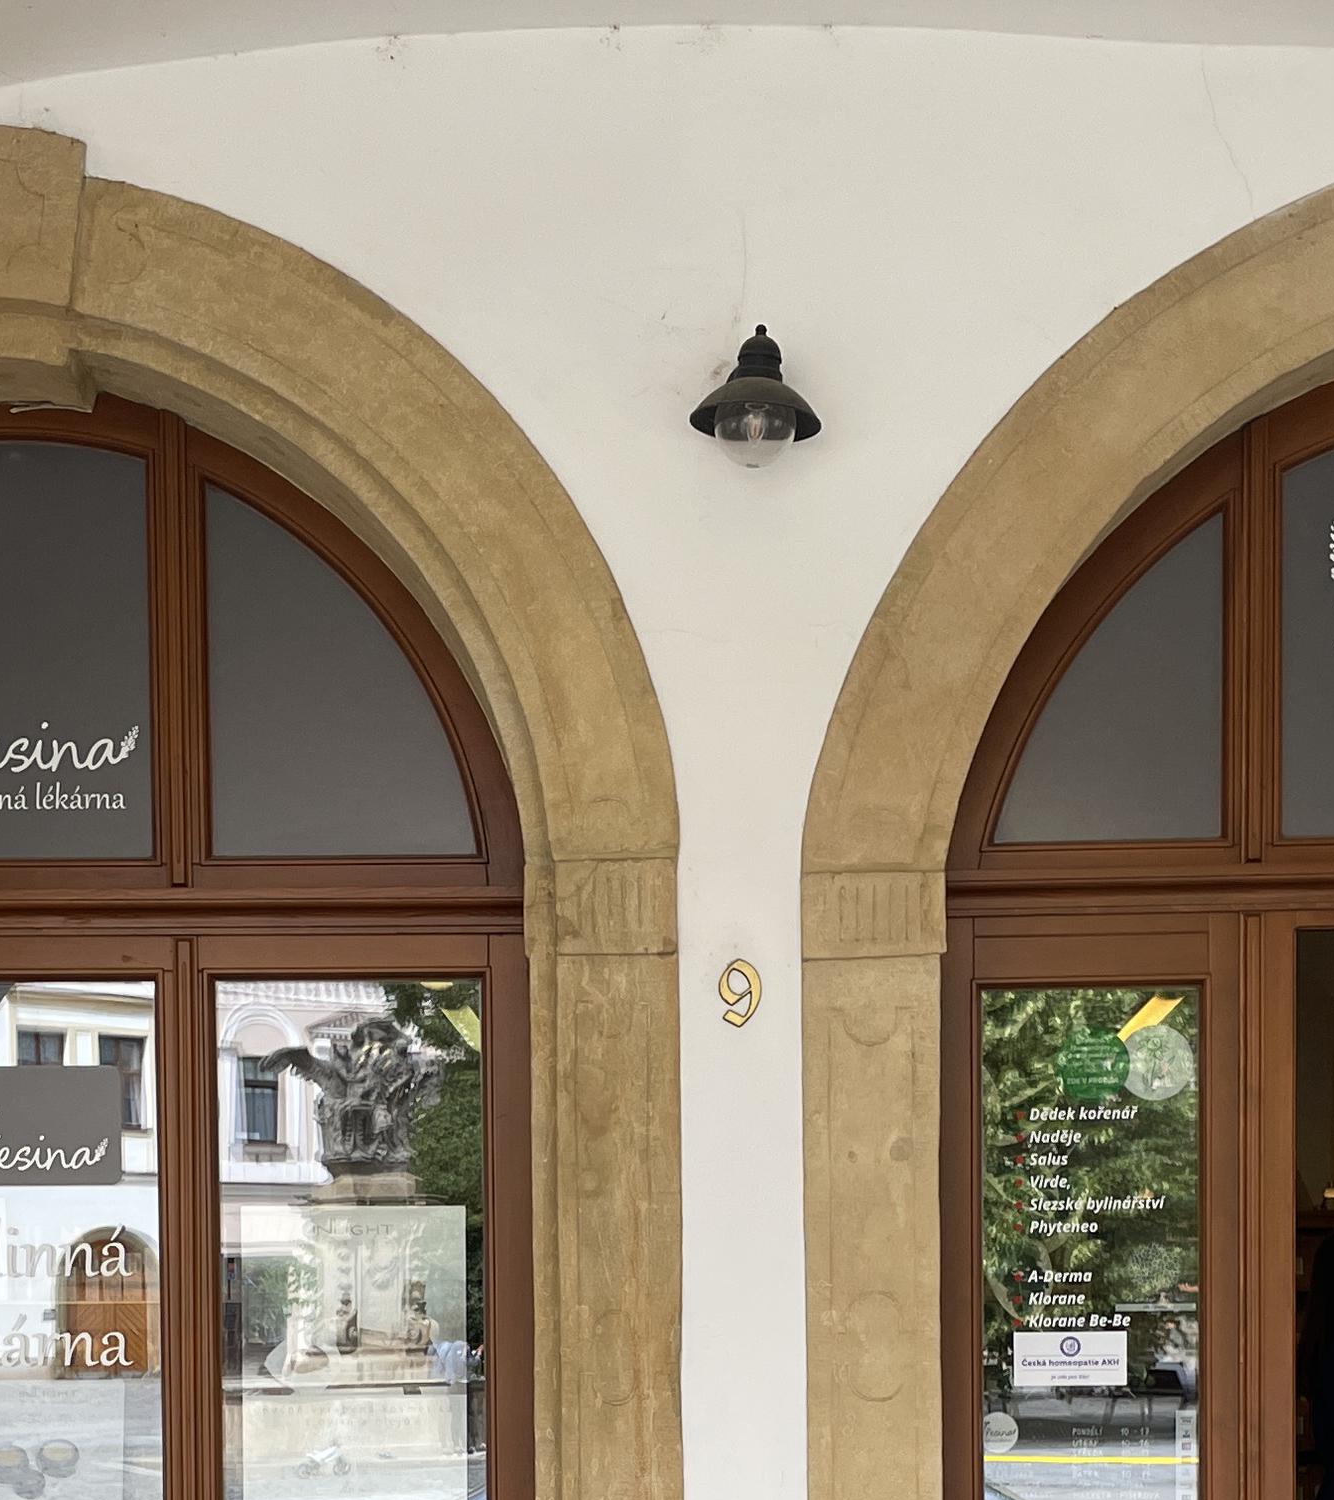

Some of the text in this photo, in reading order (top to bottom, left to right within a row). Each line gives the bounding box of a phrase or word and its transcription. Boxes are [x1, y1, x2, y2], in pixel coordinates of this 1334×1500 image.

[35, 781, 126, 810] lékárna
[718, 958, 762, 1028] 9
[1078, 1105, 1139, 1121] kořenář
[1028, 1129, 1082, 1147] Naděje
[1029, 1152, 1068, 1166] Salus
[1086, 1195, 1166, 1214] bylinářství
[1029, 1220, 1099, 1237] Phyteneo
[1027, 1270, 1093, 1284] A-Derma
[1028, 1292, 1086, 1306] Klorane
[1028, 1313, 1132, 1329] Klorane Be-Be
